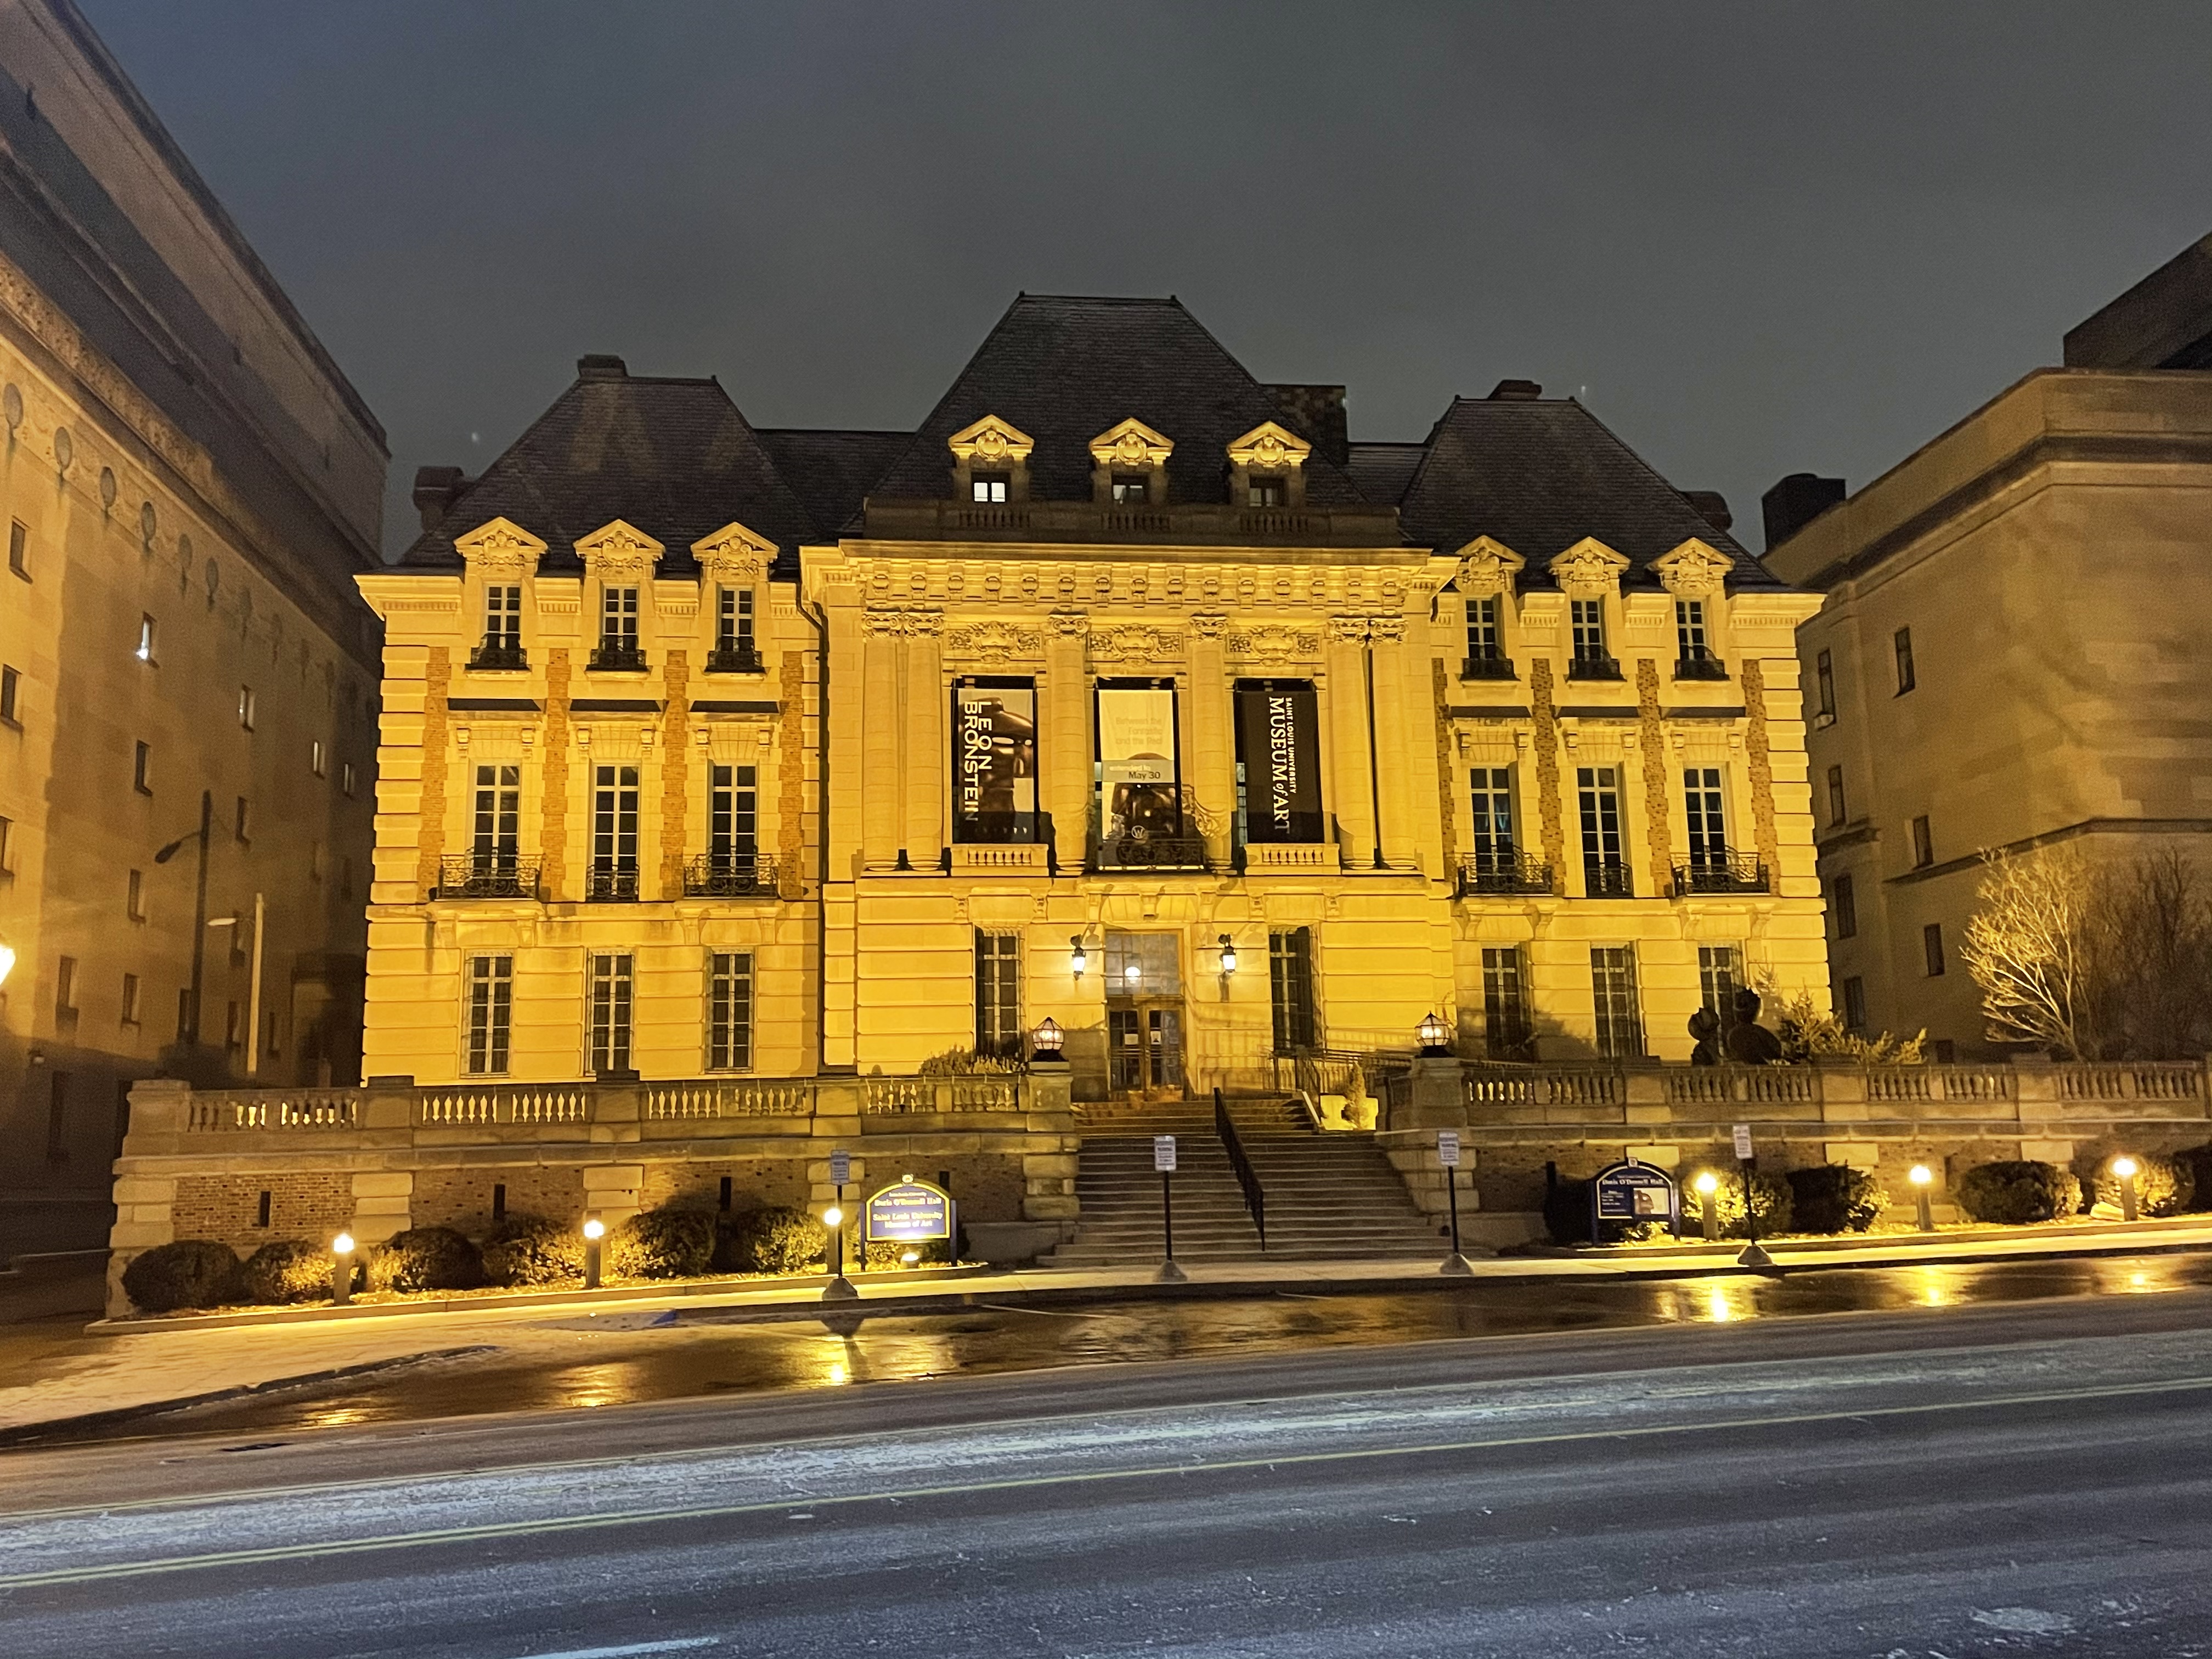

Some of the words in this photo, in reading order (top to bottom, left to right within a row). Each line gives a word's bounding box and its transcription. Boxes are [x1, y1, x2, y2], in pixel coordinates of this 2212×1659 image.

[978, 701, 992, 769] LEON
[1269, 697, 1288, 781] MUSEUM
[964, 701, 979, 821] BRONSTEIN
[1128, 771, 1147, 781] May
[1288, 747, 1296, 793] UNIVERSITY
[1273, 783, 1288, 796] of
[1273, 794, 1290, 834] ART
